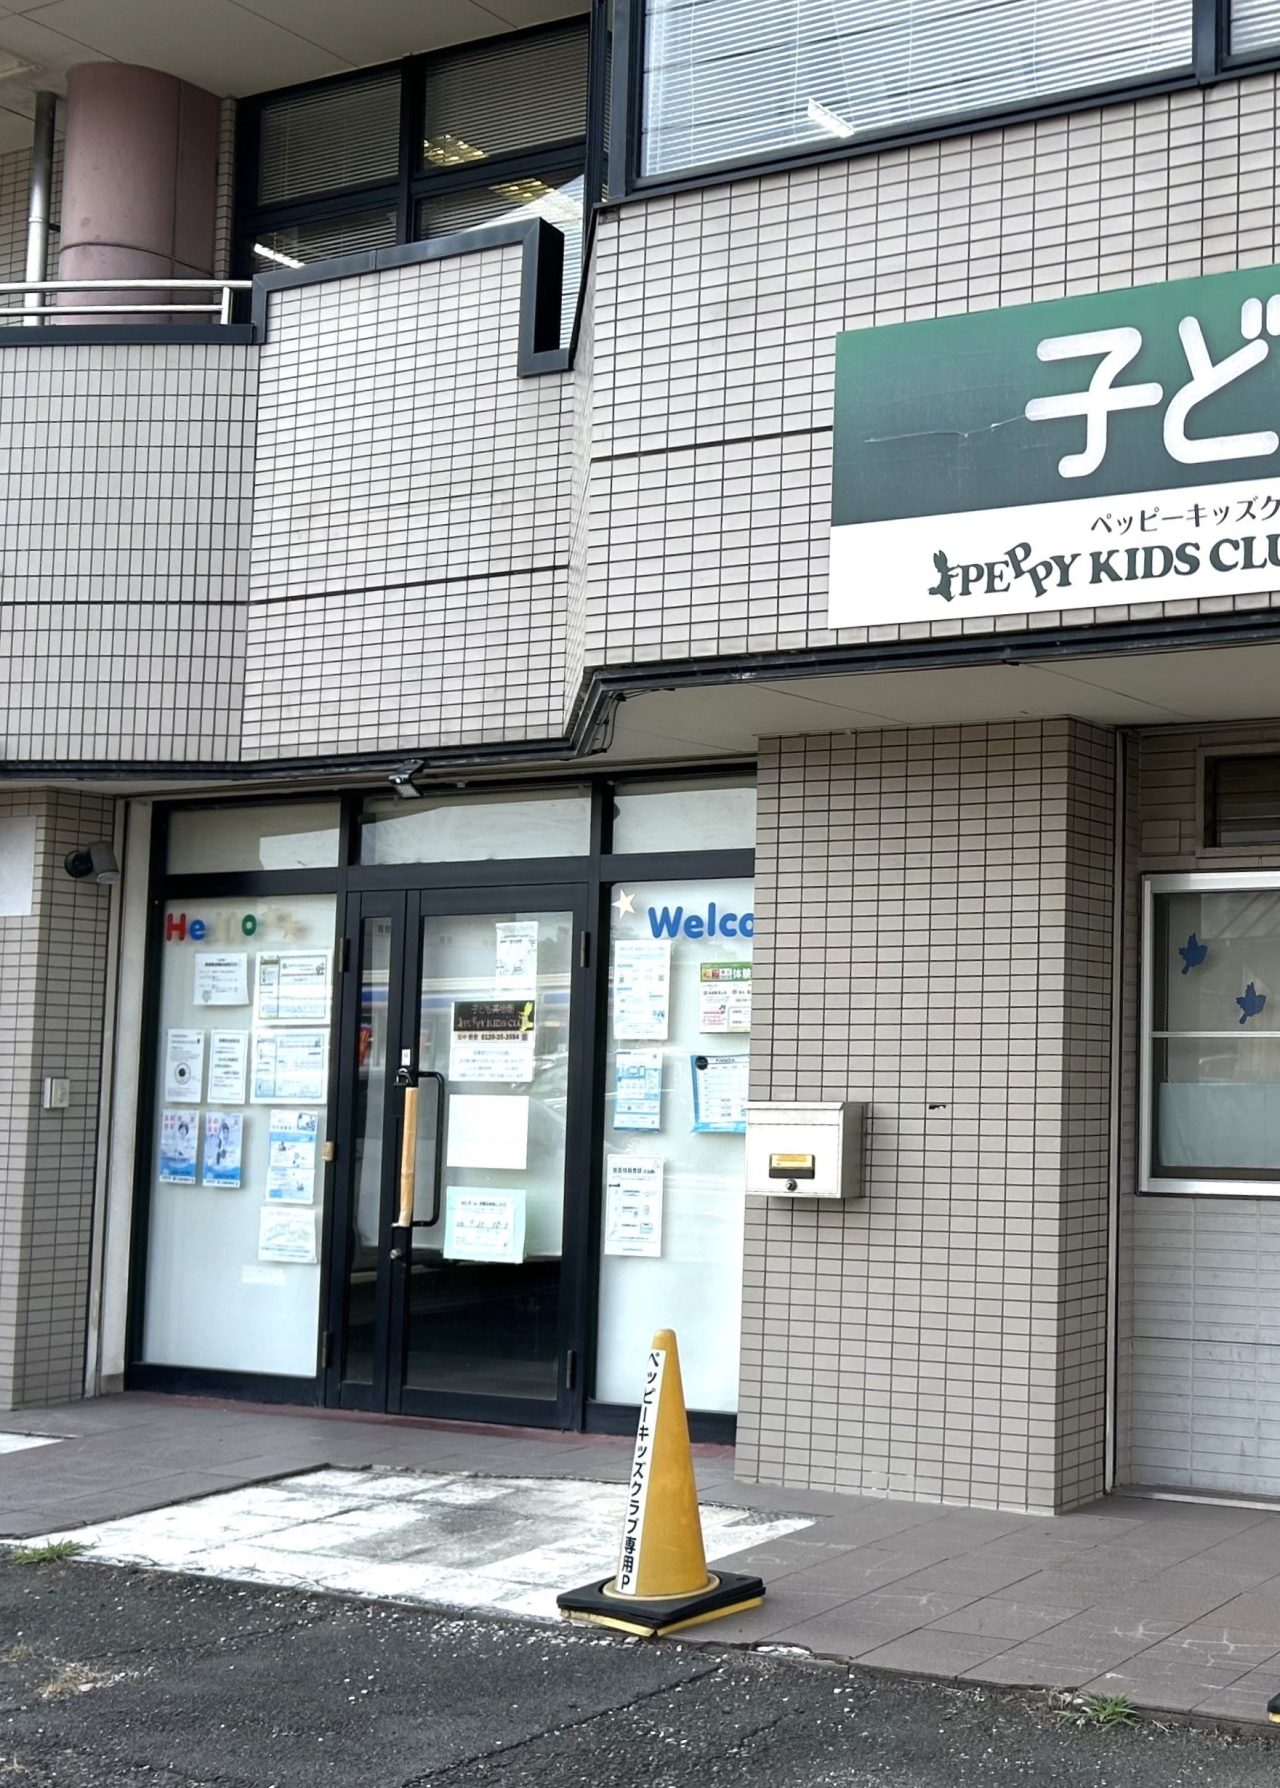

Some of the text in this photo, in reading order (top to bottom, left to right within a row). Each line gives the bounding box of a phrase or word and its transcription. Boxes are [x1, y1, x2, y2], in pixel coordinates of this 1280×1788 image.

[958, 541, 1082, 598] PEPPY
[1089, 542, 1200, 585] KIDS
[621, 1352, 660, 1590] ペッピーキッズクラブ専用P
